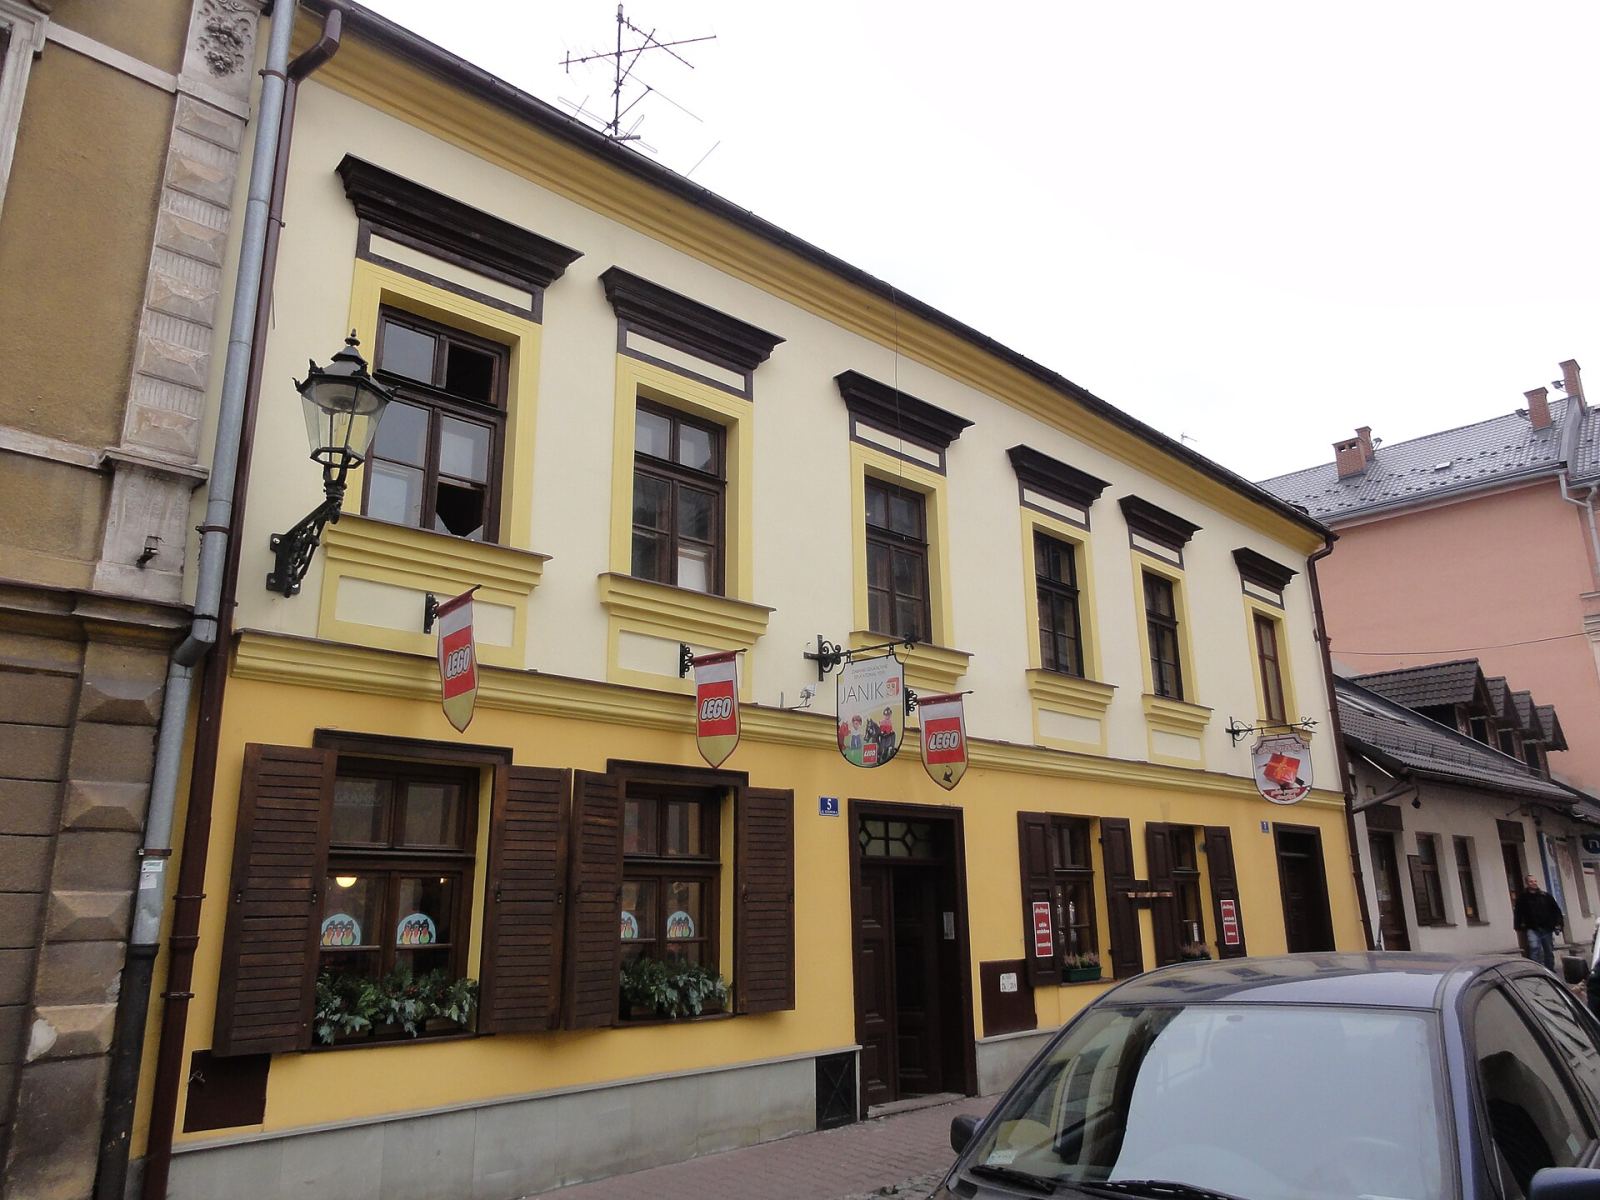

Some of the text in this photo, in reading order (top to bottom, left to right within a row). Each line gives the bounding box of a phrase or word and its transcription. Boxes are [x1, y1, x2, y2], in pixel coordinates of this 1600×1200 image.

[446, 645, 471, 679] LEGO
[841, 681, 884, 704] JANIK
[701, 697, 733, 720] LEGO
[928, 731, 960, 751] LEGO
[827, 798, 832, 811] 5
